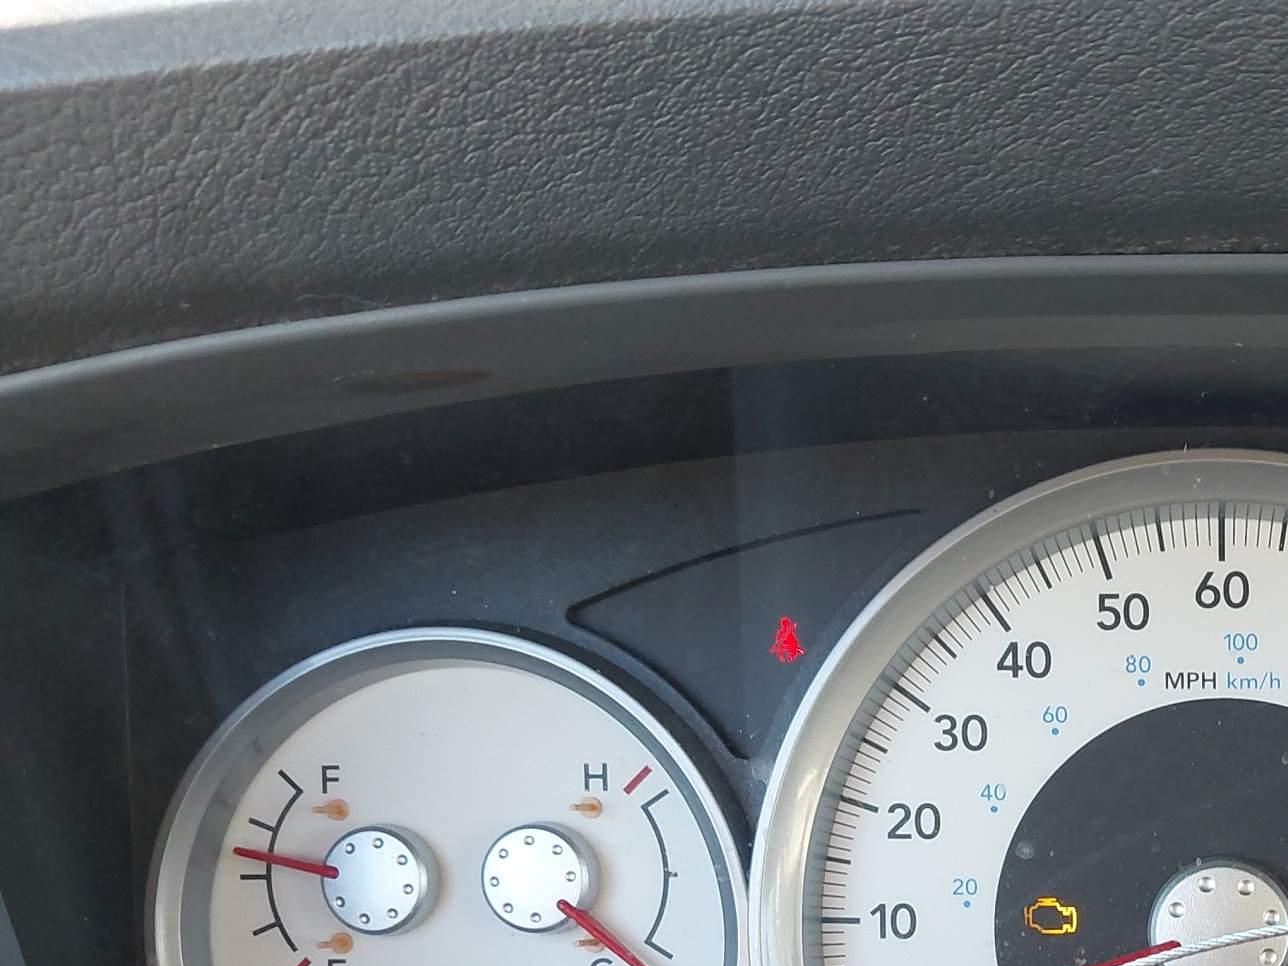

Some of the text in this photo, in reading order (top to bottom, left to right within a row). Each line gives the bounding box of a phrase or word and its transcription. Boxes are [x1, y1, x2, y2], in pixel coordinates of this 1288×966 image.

[1195, 570, 1250, 609] 60
[1096, 593, 1150, 631] 50
[1222, 632, 1259, 652] 100
[996, 641, 1052, 679] 40
[1125, 654, 1152, 674] 80
[1165, 671, 1281, 690] MPH km/h
[1042, 706, 1068, 724] 60
[934, 714, 988, 752] 30
[320, 764, 341, 794] F
[583, 762, 608, 792] H
[980, 783, 1007, 801] 40
[887, 802, 941, 840] 20
[952, 878, 978, 896] 20
[870, 903, 917, 940] 10
